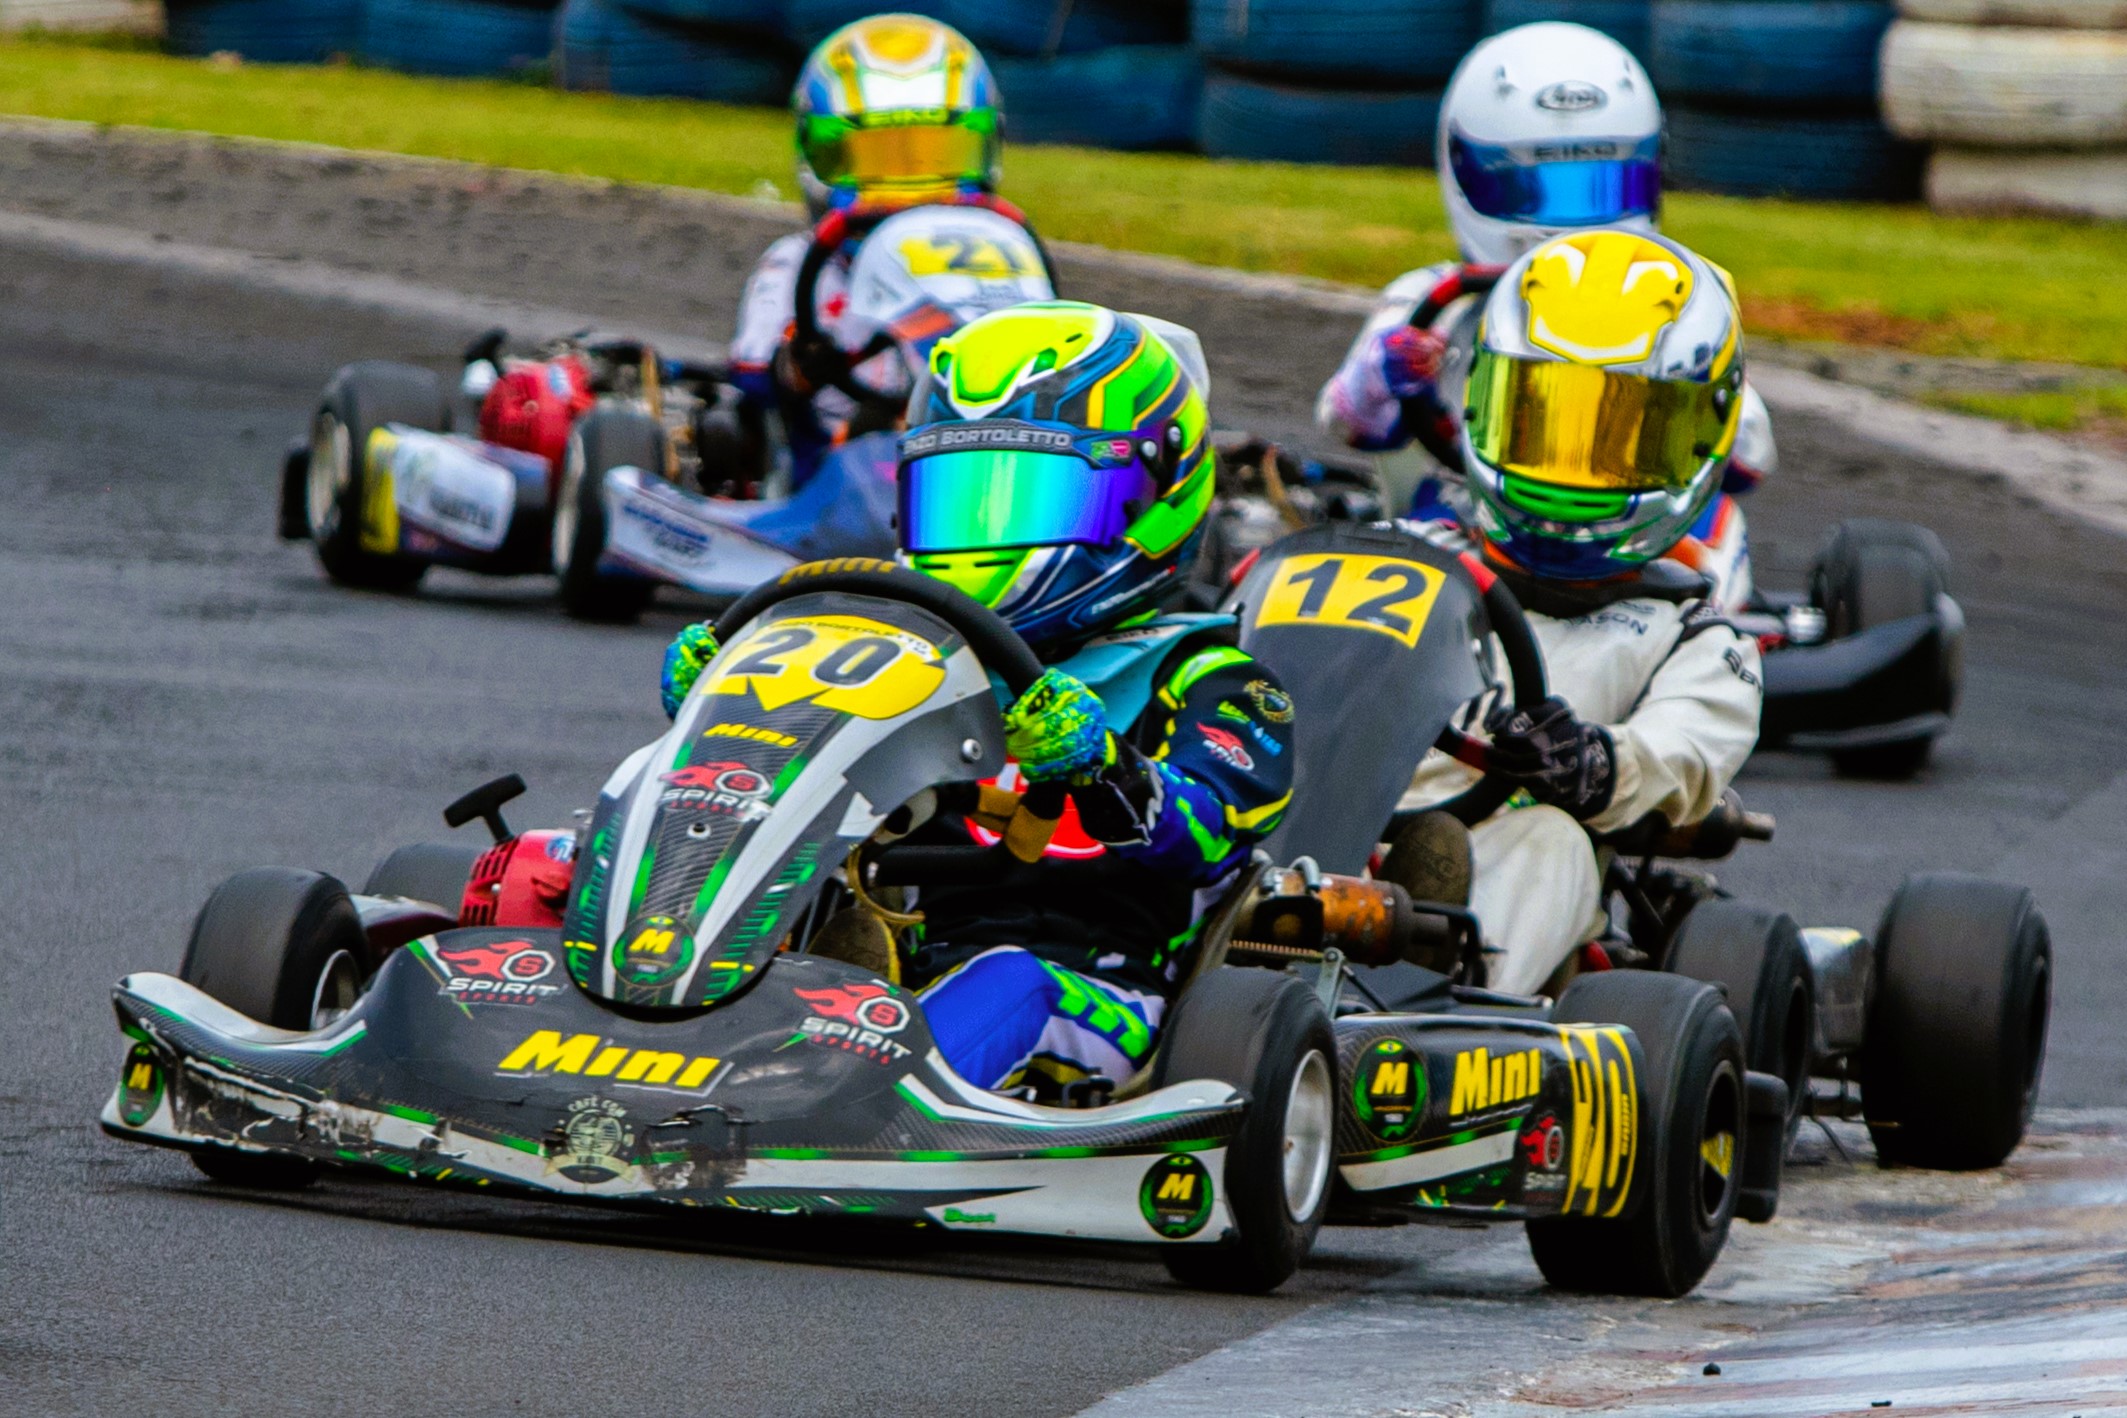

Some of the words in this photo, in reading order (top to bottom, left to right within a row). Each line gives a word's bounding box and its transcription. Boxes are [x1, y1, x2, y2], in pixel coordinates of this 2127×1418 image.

[940, 429, 1071, 447] BORTOLETTO
[1288, 559, 1427, 636] 12
[725, 628, 901, 687] 20
[660, 787, 772, 822] SPIRIT
[628, 928, 676, 954] M
[447, 978, 559, 997] SPIRIT
[800, 1016, 913, 1059] SPIRIT
[499, 1030, 720, 1088] Mini
[128, 1063, 152, 1090] M
[1371, 1062, 1409, 1094] M
[1449, 1047, 1541, 1116] Mini
[1157, 1173, 1196, 1200] M
